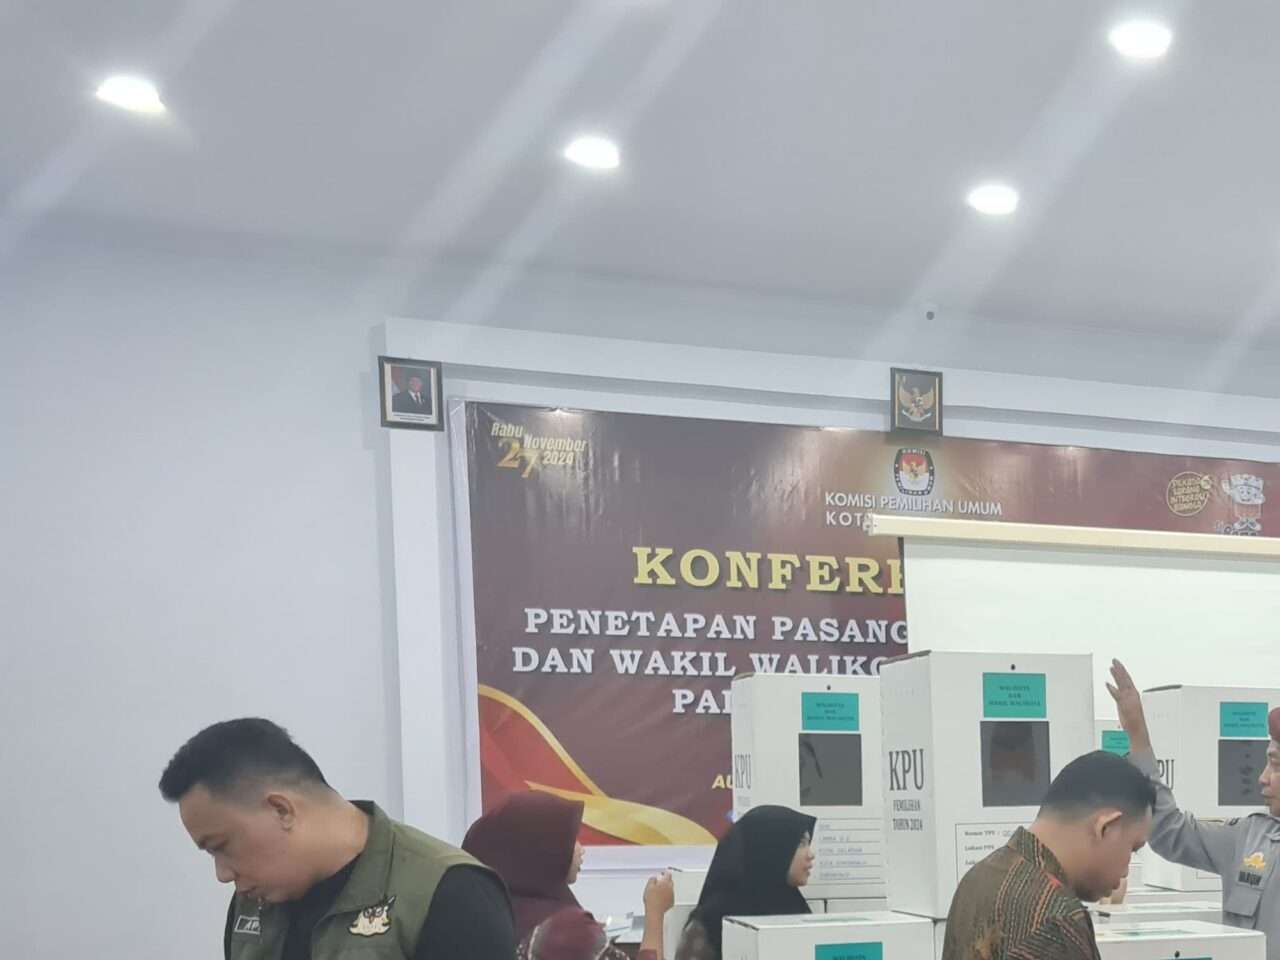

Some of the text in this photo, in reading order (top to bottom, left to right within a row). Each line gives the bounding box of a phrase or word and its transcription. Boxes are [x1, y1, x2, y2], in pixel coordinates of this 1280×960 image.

[491, 422, 523, 438] Rabu
[523, 433, 587, 452] November
[824, 491, 1003, 516] KOMISI PEMILIHAN UMUM
[825, 511, 866, 527] KOT
[524, 607, 757, 640] PENETAPAN
[512, 646, 595, 674] DAN
[609, 649, 736, 677] WAKIL
[735, 753, 751, 790] KPU
[889, 748, 924, 791] KPU
